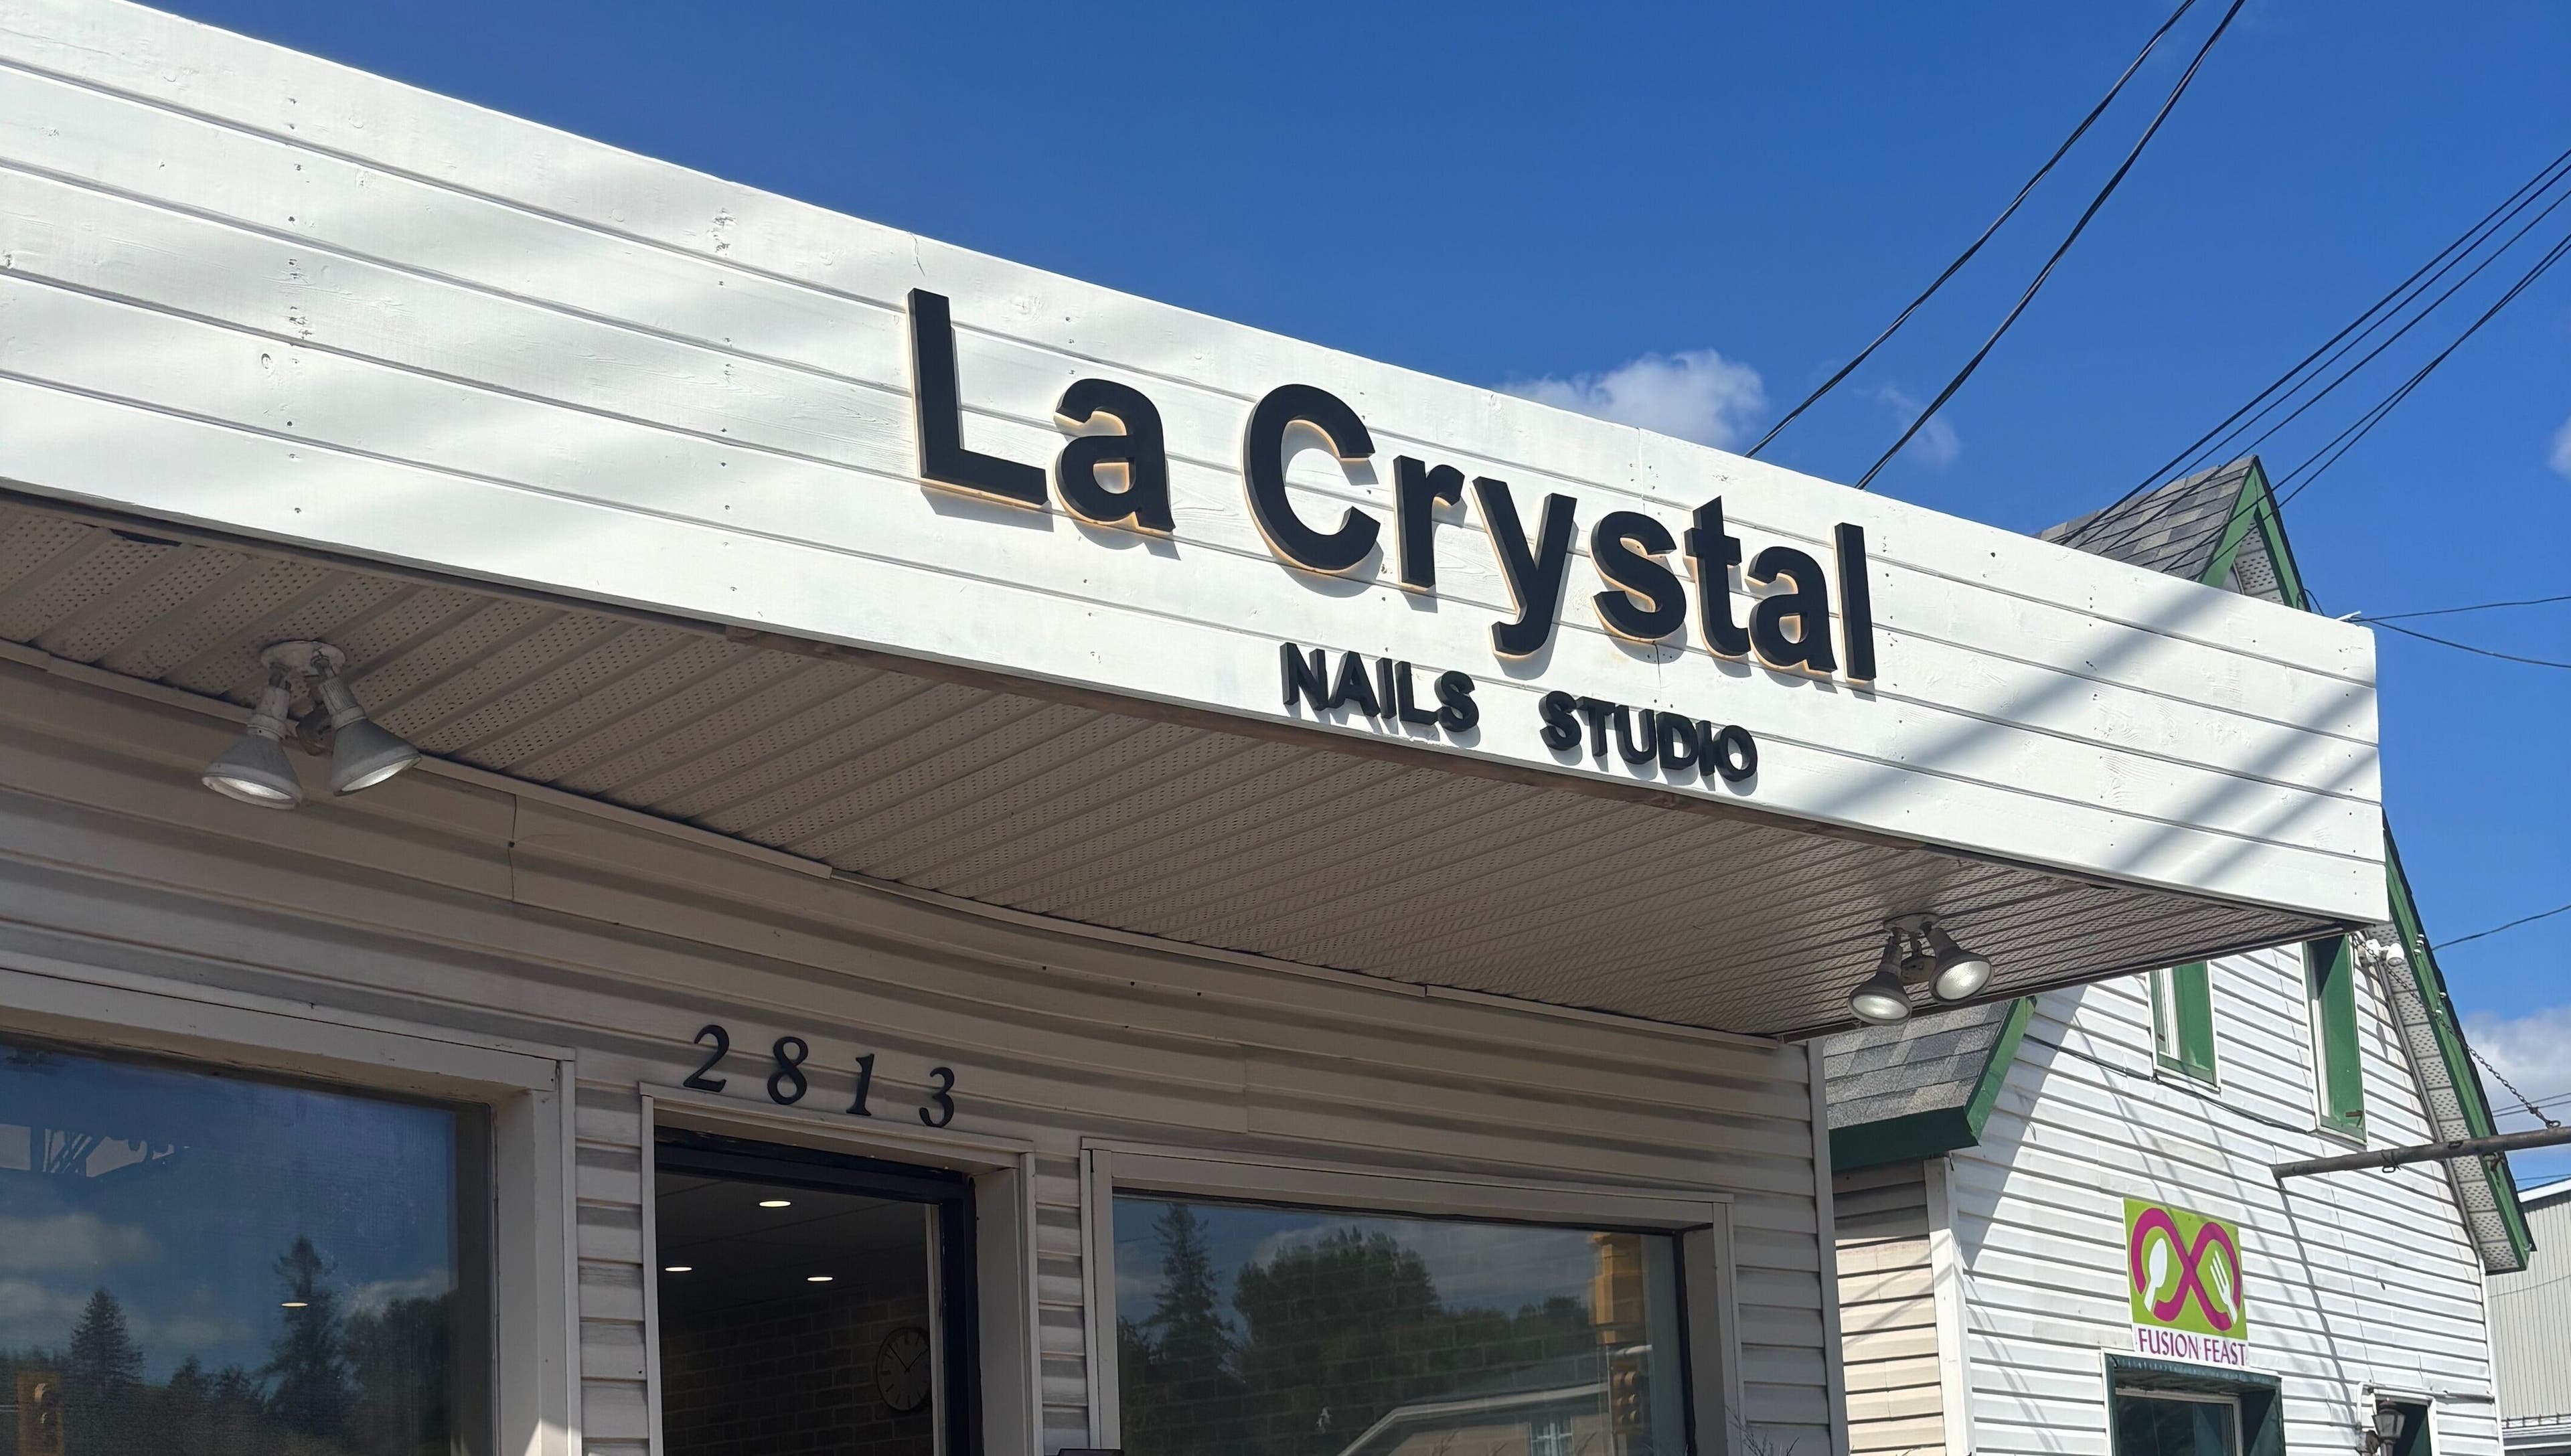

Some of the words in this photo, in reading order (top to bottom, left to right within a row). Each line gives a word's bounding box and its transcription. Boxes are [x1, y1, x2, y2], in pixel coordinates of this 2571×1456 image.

[907, 287, 1176, 533] La
[1242, 383, 1877, 683] Crystal
[1279, 642, 1480, 732] NAILS
[1539, 690, 1758, 783] STUDIO
[682, 1024, 955, 1128] 2813
[2138, 1327, 2199, 1361] FUSION
[2203, 1338, 2246, 1366] FEAST
